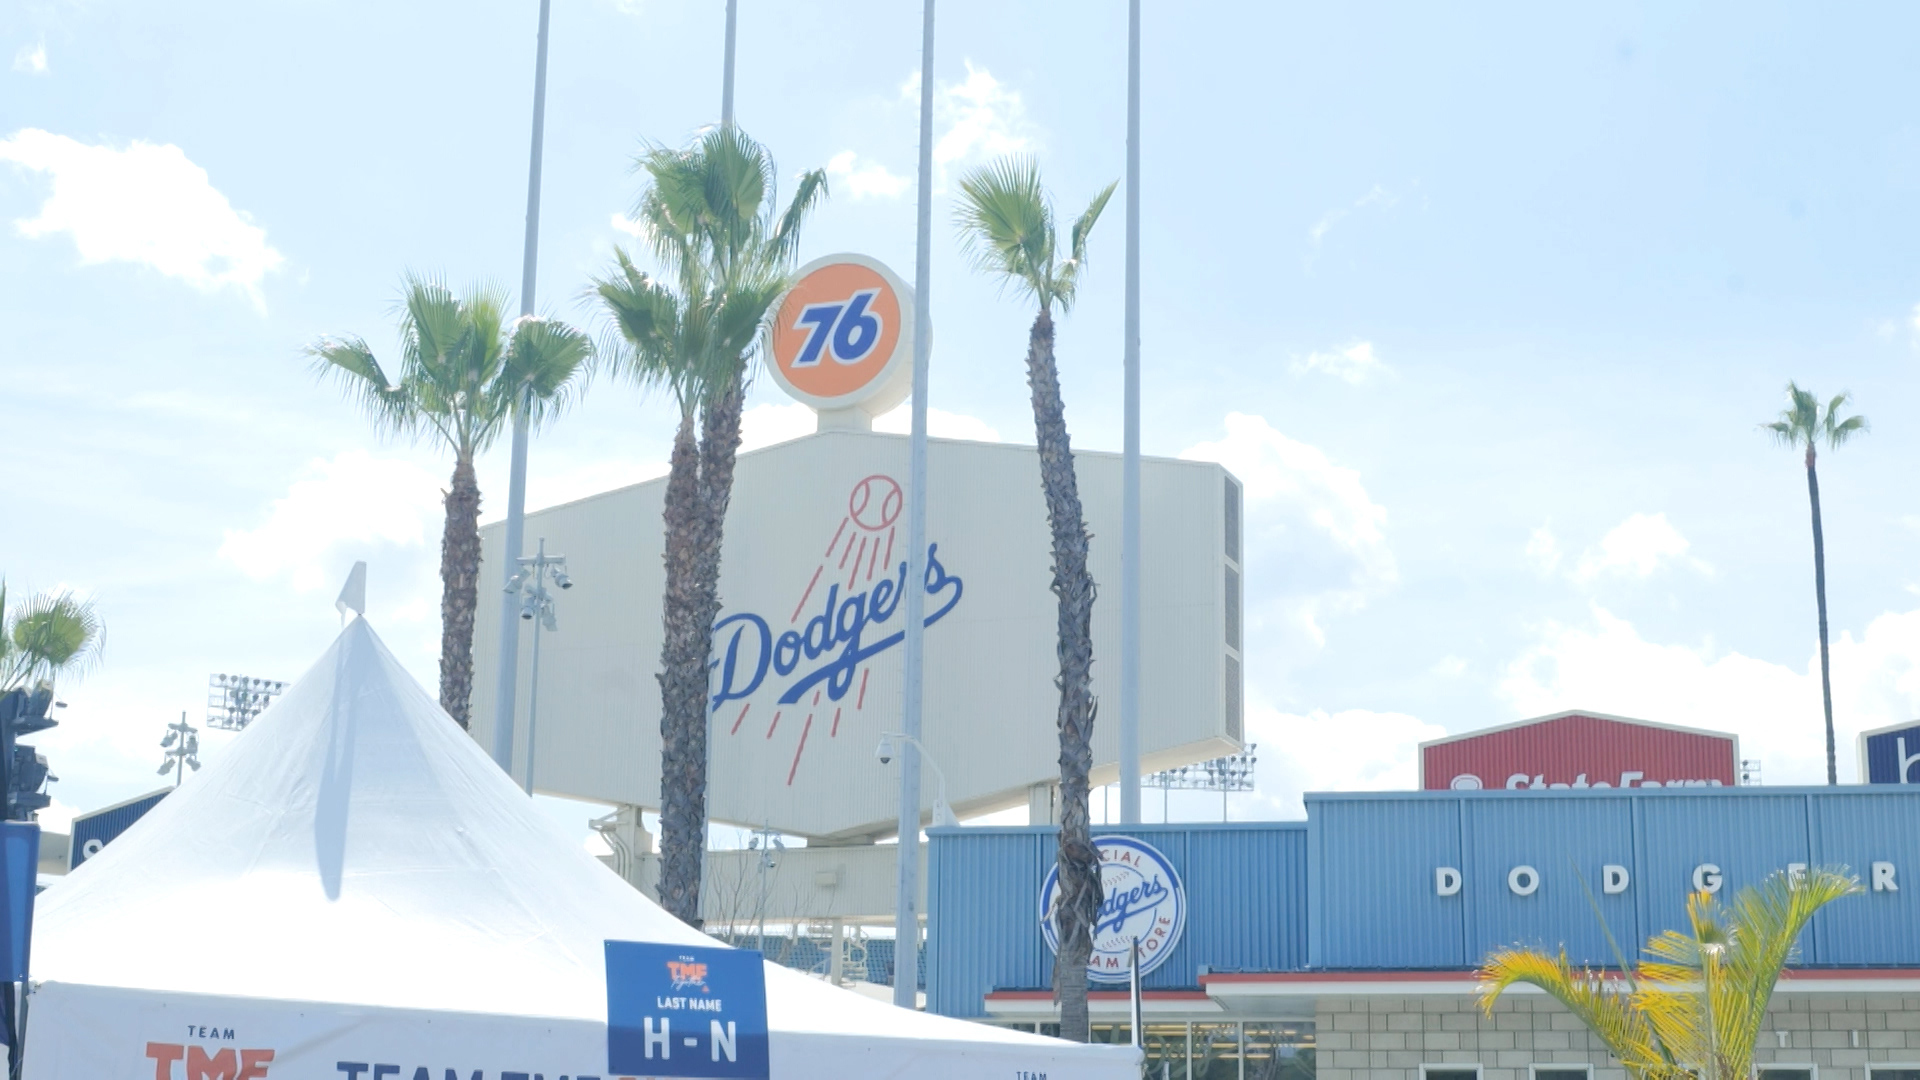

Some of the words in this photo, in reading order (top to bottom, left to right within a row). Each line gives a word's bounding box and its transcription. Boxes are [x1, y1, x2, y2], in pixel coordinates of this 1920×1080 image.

[790, 287, 882, 368] 76
[1099, 849, 1141, 868] CIAL
[1095, 873, 1169, 933] dgers
[1137, 915, 1171, 959] TORE
[657, 996, 687, 1010] LAST
[689, 997, 722, 1012] NAME
[187, 1024, 235, 1040] TEAM
[643, 1016, 670, 1060] H
[710, 1019, 737, 1063] N
